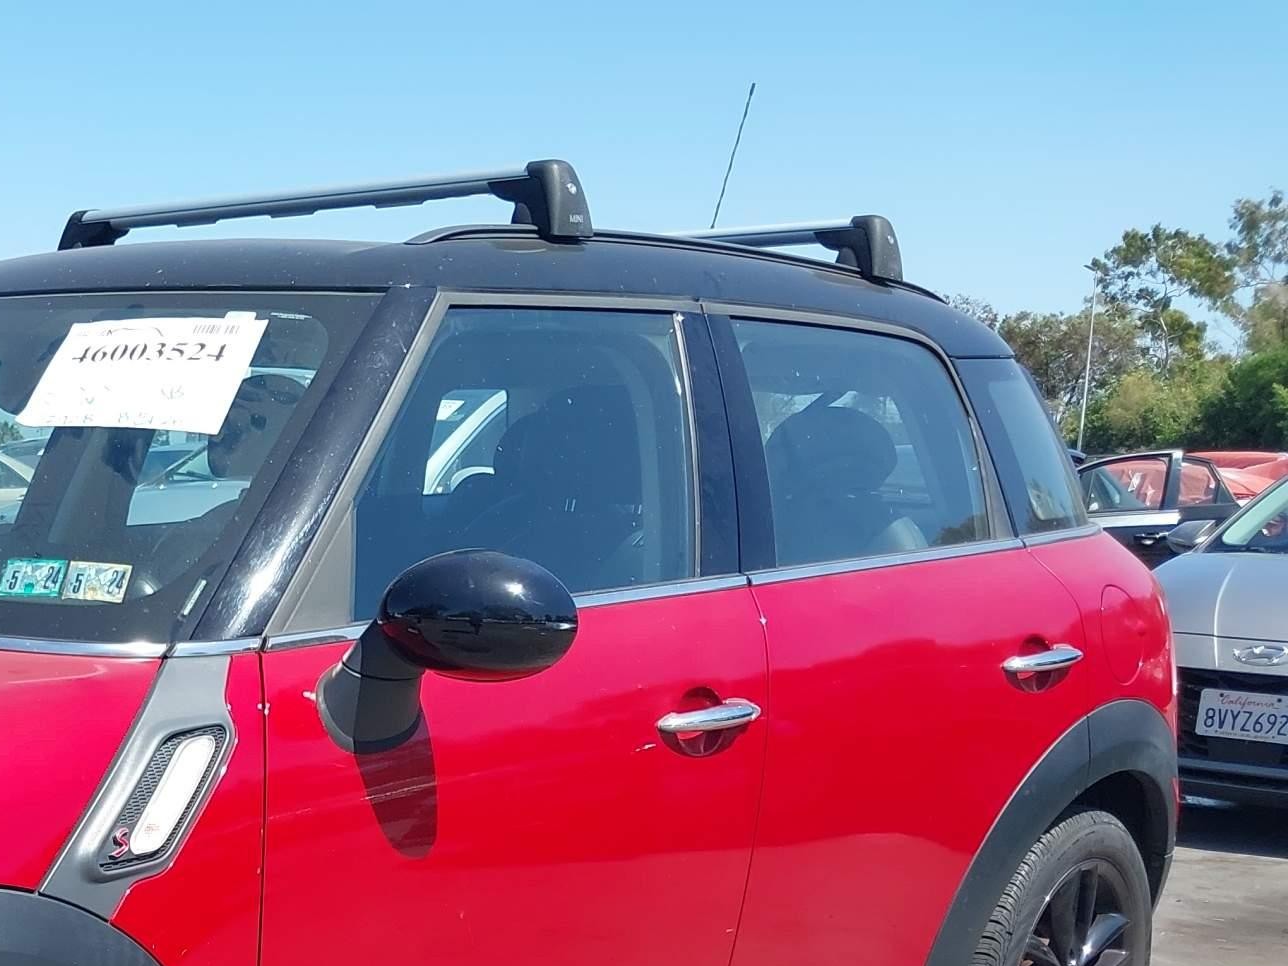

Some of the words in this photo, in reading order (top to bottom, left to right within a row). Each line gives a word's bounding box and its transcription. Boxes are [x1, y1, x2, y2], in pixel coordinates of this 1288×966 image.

[71, 341, 227, 363] 46003524
[43, 566, 62, 590] 24
[1220, 693, 1277, 710] California
[1203, 706, 1288, 737] 8VYZ692
